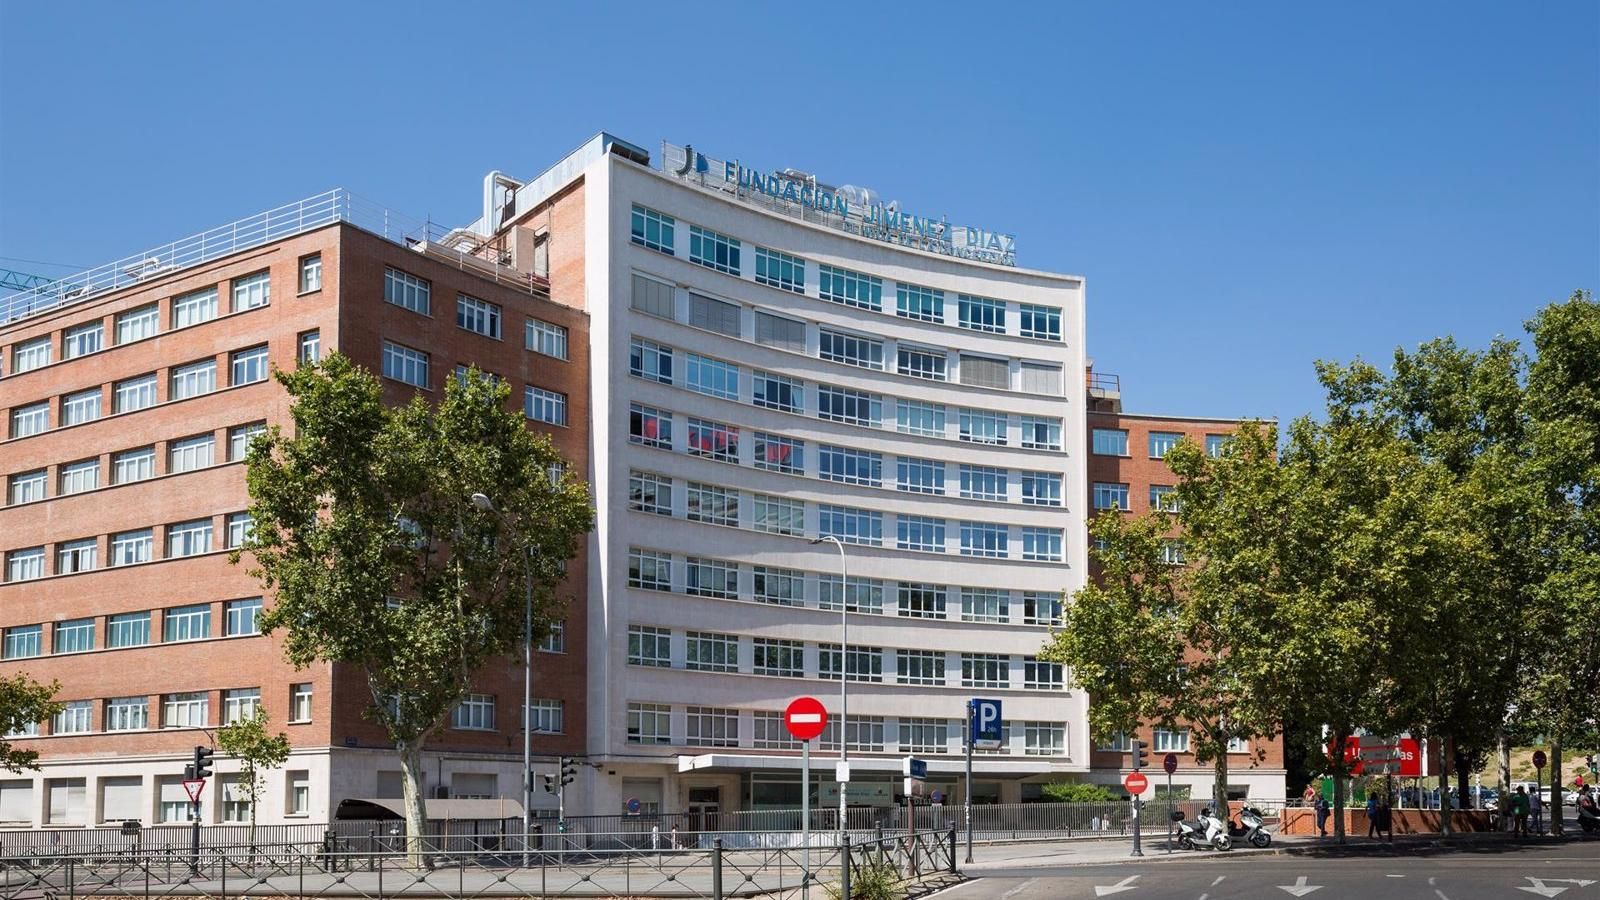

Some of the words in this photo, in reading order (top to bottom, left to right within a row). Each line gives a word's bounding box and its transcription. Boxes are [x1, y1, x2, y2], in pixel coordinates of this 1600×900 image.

[724, 160, 849, 217] FUNDACION
[863, 203, 952, 241] JIMENEZ
[966, 225, 1017, 252] DIAZ
[980, 702, 997, 732] P
